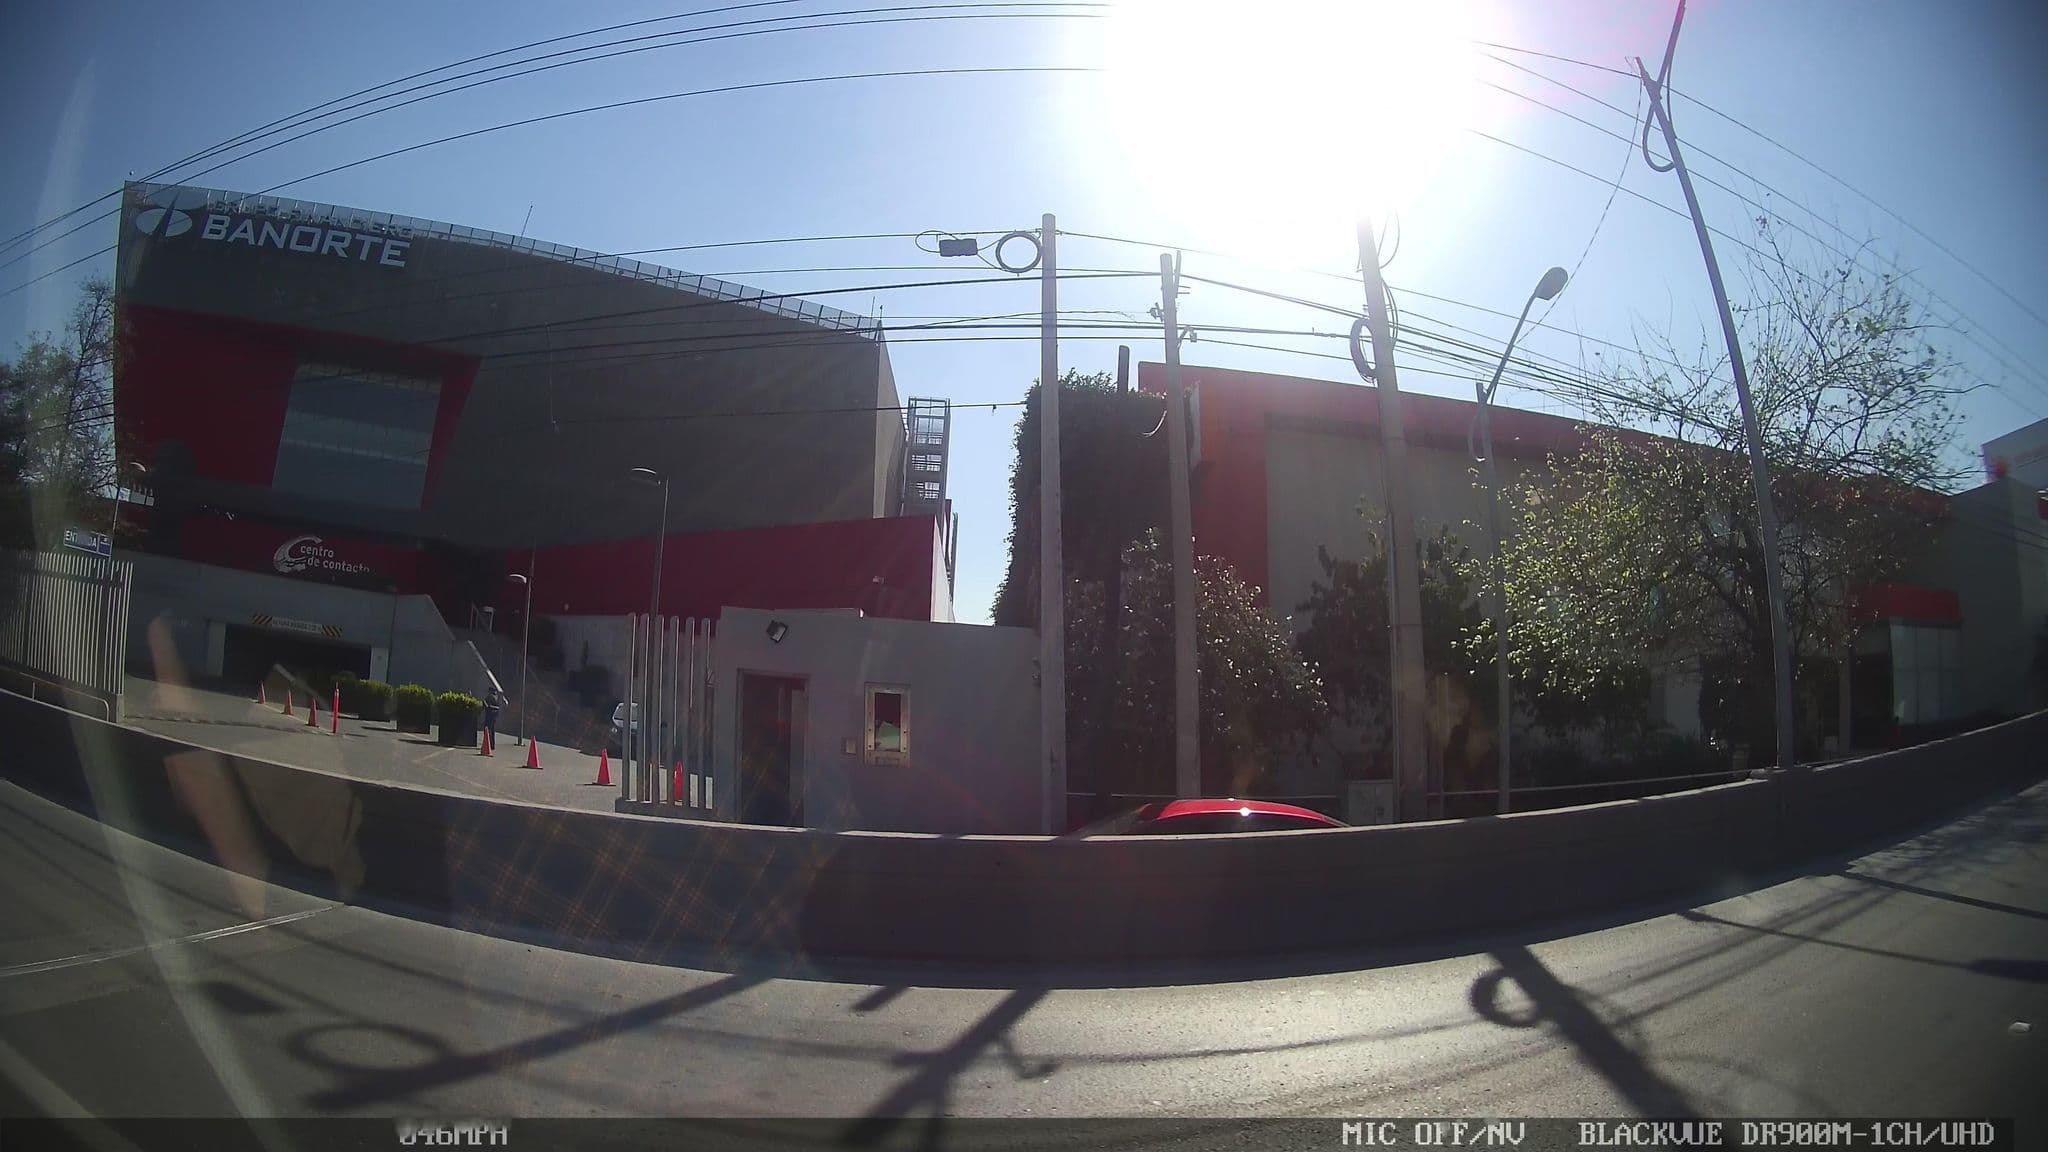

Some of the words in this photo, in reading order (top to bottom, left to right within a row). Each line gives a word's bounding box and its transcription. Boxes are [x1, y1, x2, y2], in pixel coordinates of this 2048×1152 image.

[200, 213, 411, 267] BANORTE
[300, 545, 334, 558] centro
[307, 556, 320, 567] de
